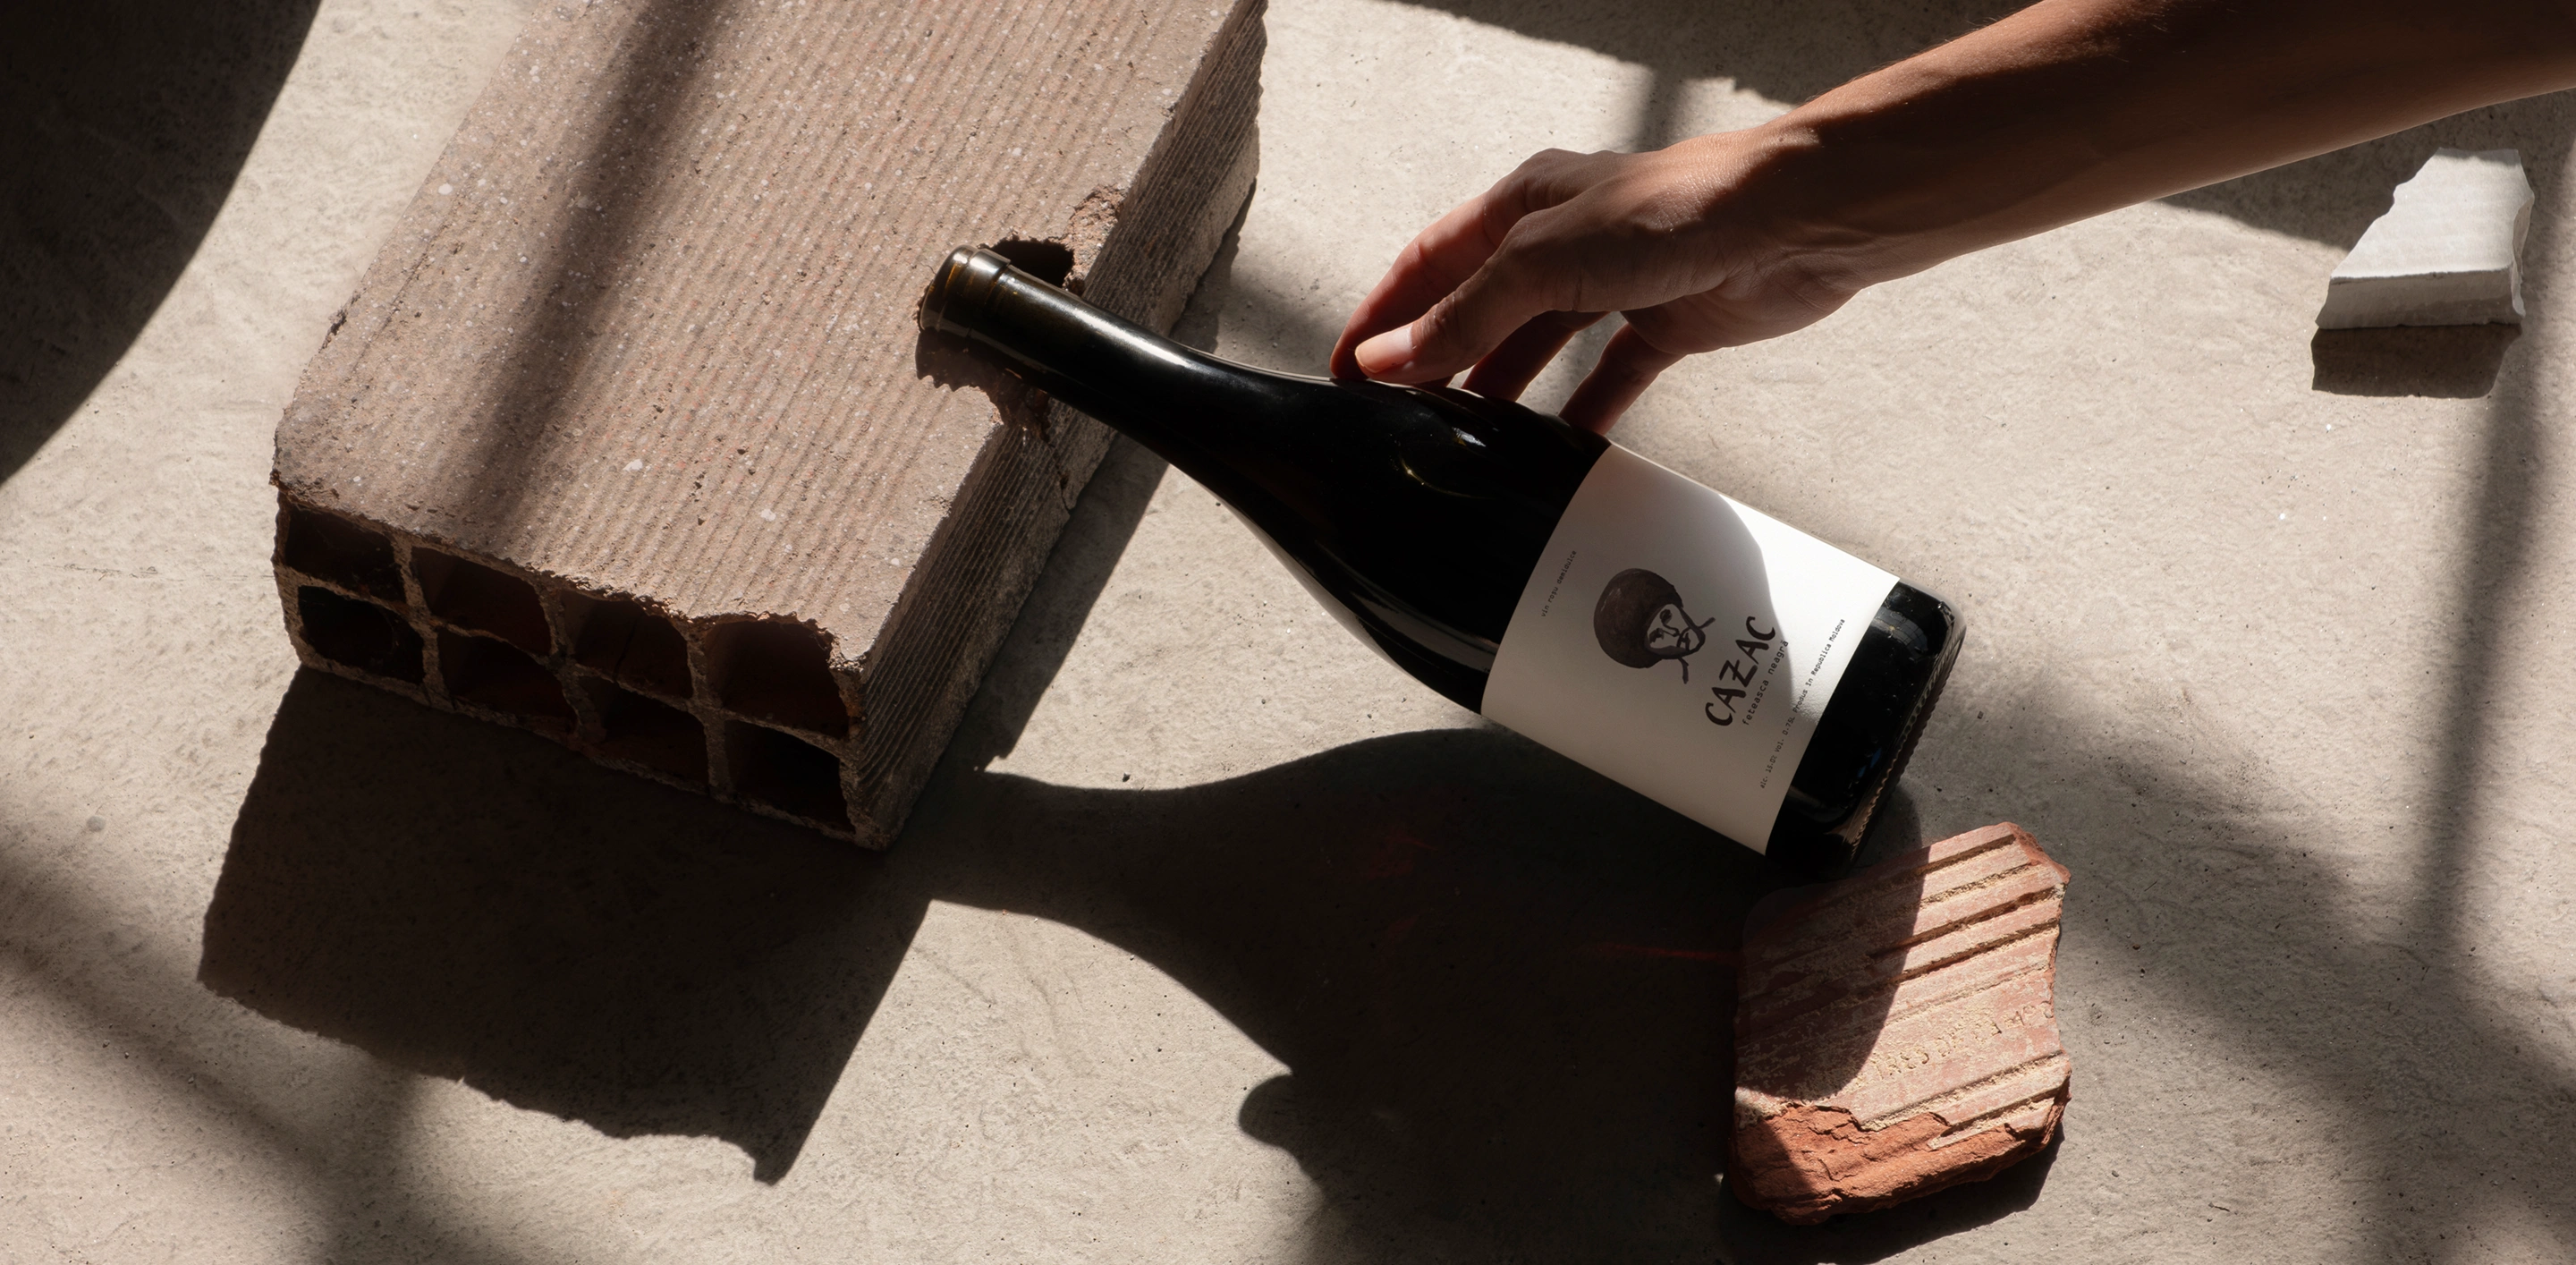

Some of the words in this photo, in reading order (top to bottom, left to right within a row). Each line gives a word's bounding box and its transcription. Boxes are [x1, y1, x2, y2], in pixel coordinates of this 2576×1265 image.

[1541, 606, 1549, 616] vin
[1557, 550, 1577, 584] demidulce
[1742, 680, 1769, 725] feteasca
[1768, 639, 1788, 675] neagră
[1792, 690, 1808, 713] Produs
[1810, 643, 1831, 676] Republica
[1829, 619, 1845, 641] Moldova
